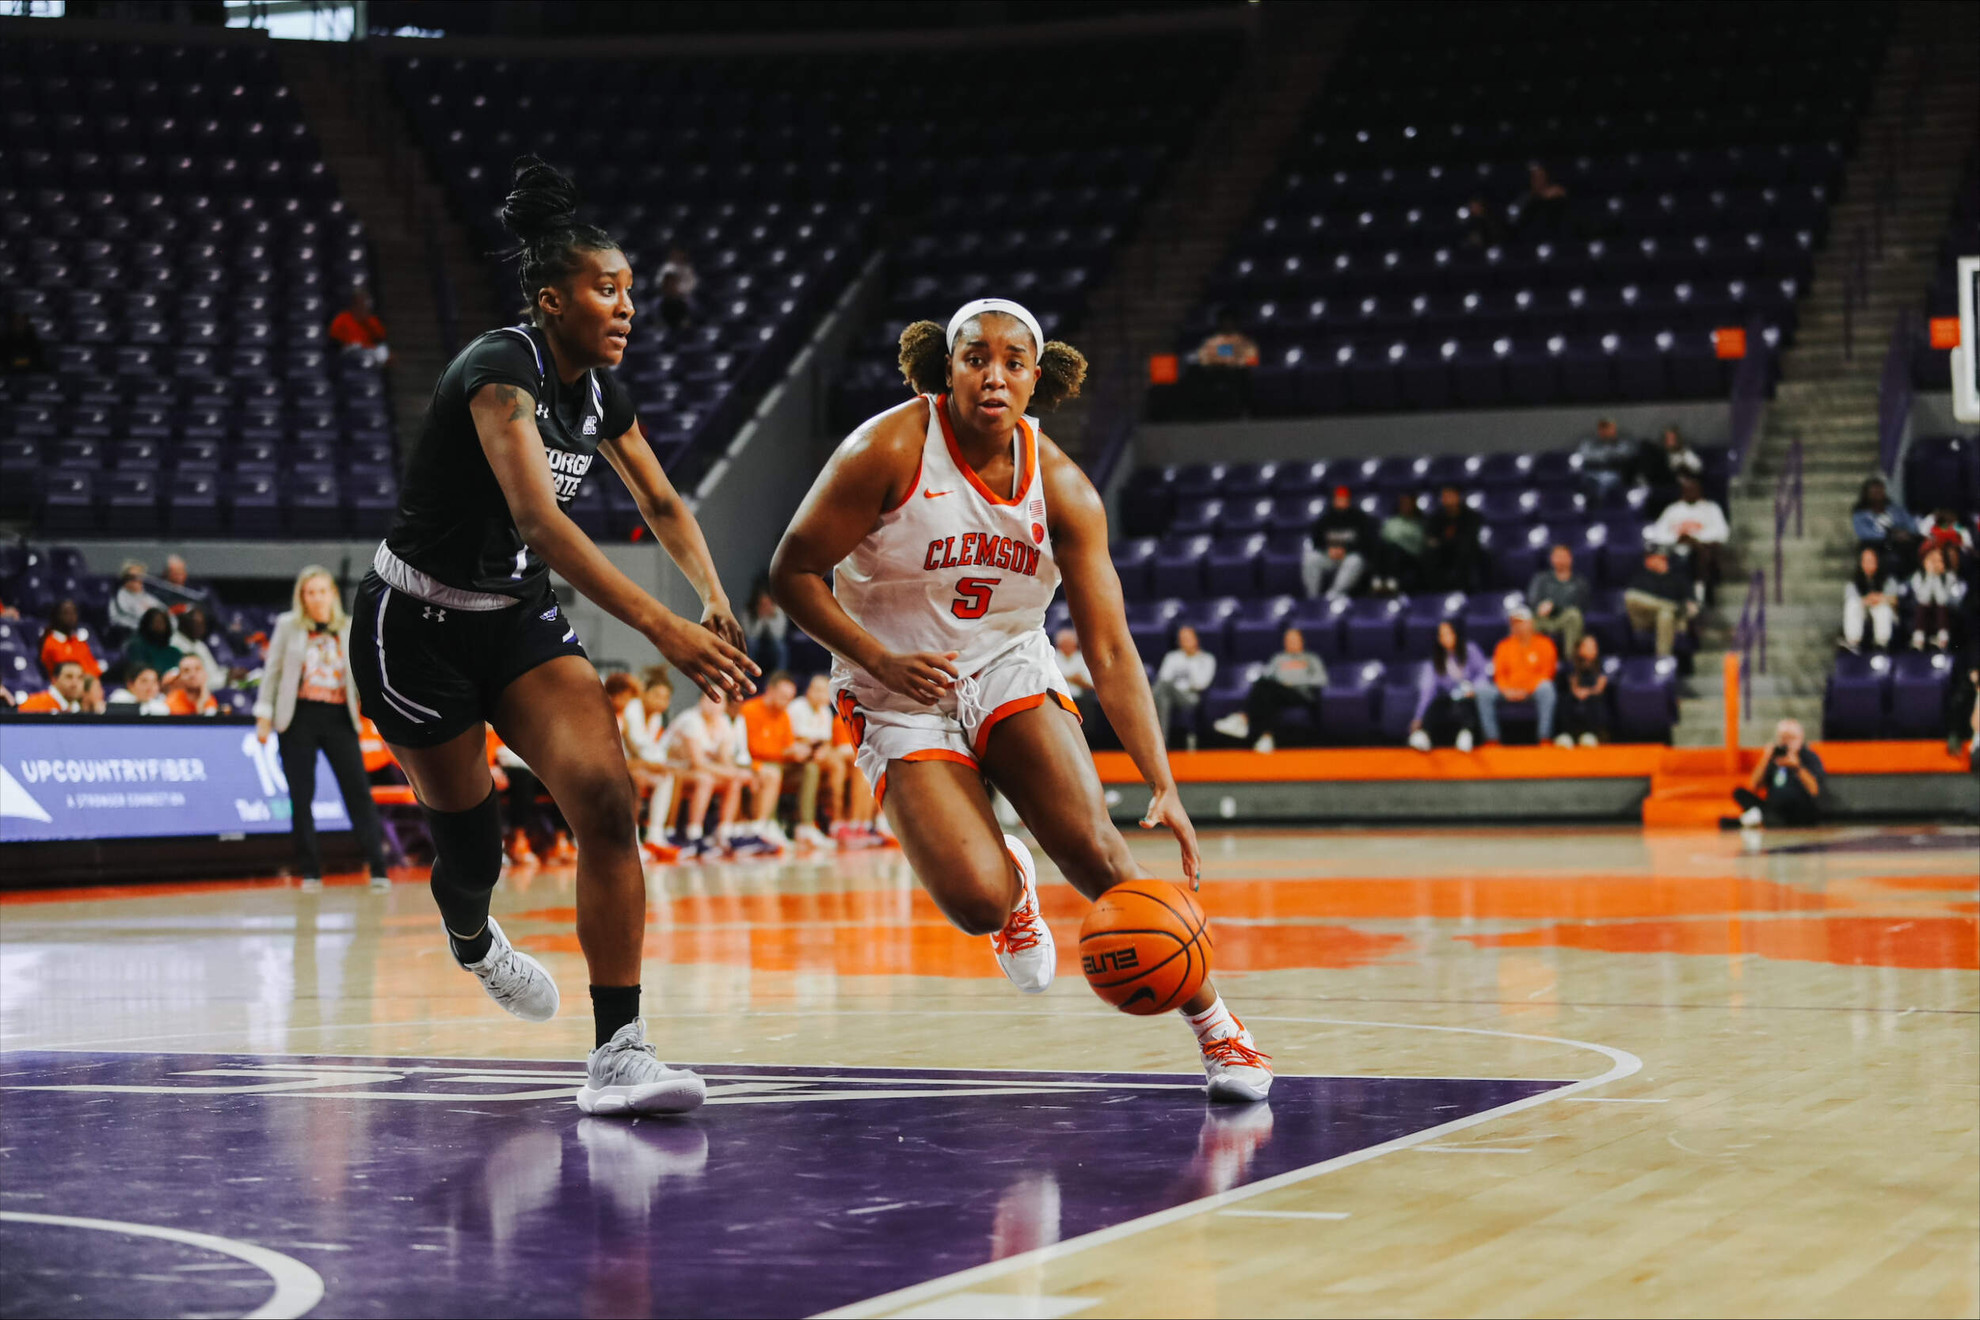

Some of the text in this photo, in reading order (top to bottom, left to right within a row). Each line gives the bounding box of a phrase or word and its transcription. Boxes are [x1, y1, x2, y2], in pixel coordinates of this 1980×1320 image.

[923, 532, 1041, 576] CLEMSON
[951, 577, 1001, 619] 5
[1082, 946, 1139, 974] ELITE
